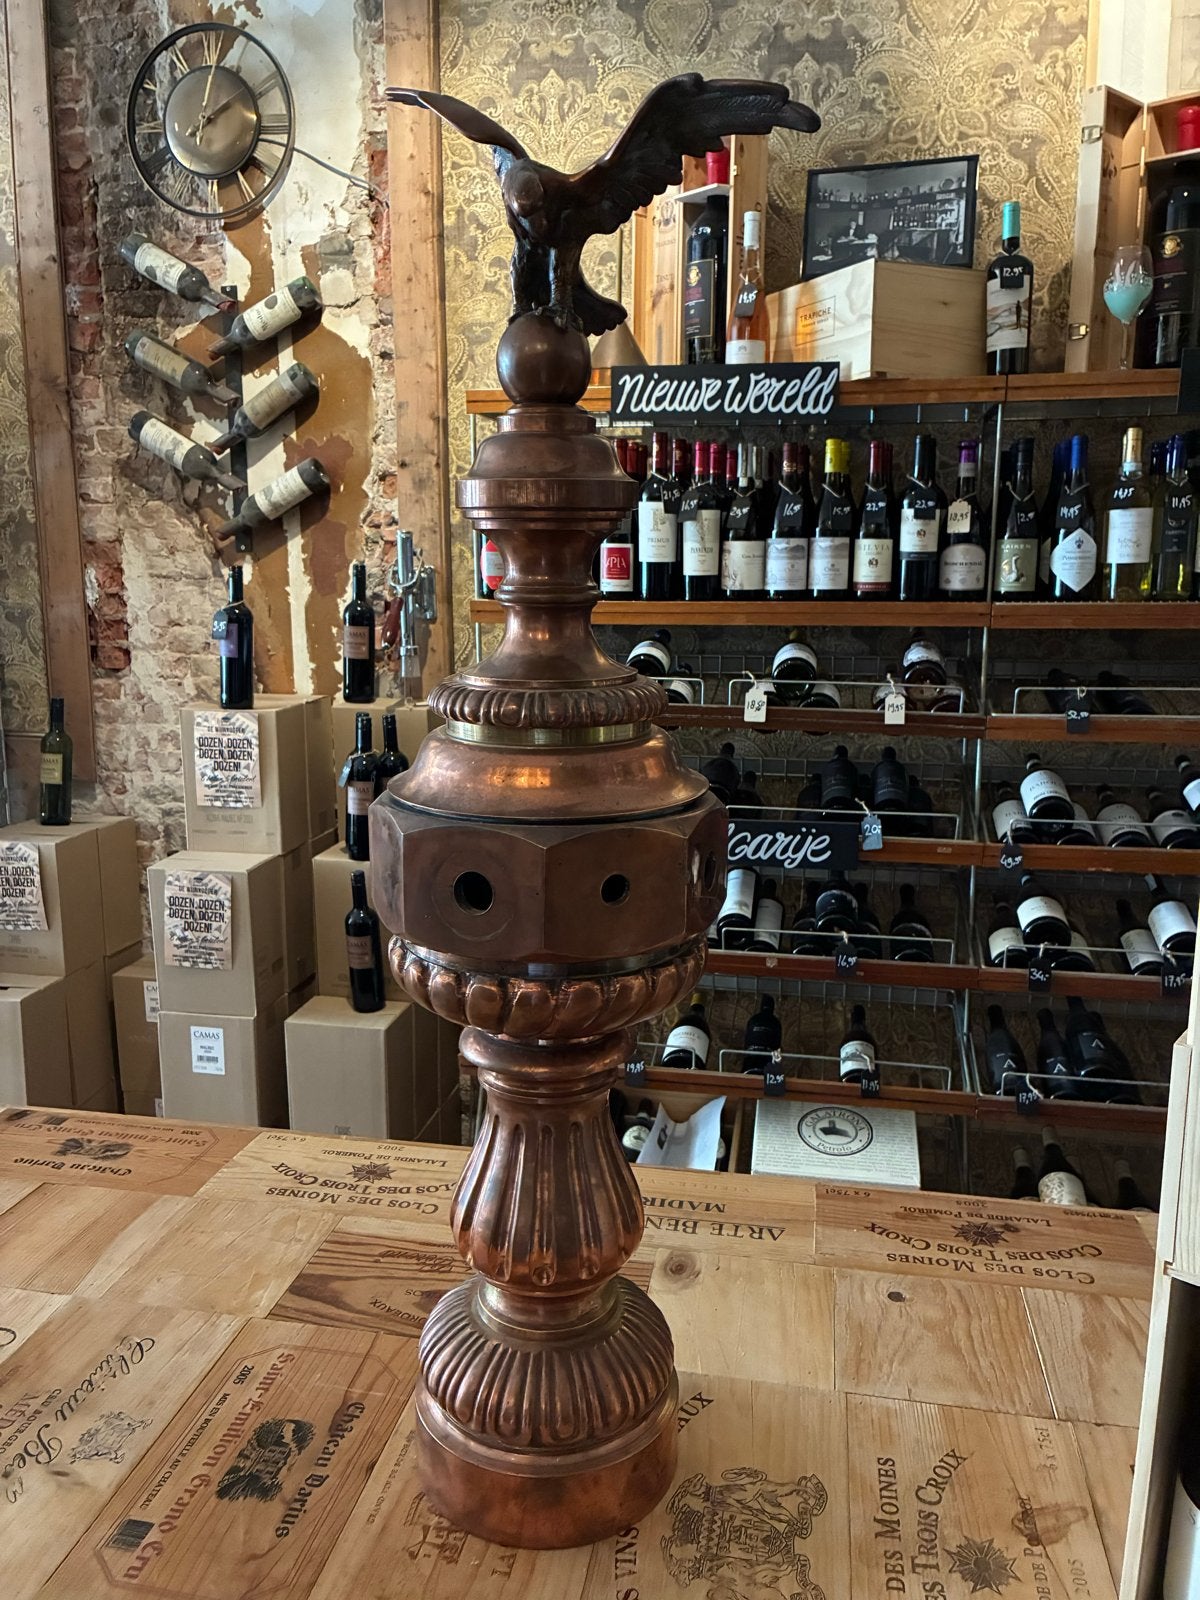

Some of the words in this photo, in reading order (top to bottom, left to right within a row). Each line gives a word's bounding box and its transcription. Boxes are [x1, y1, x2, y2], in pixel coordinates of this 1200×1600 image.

[799, 306, 832, 323] TRAPICHE
[616, 372, 722, 414] Nieuwe
[723, 366, 839, 415] Wereld
[193, 1030, 220, 1040] CAMAS
[804, 1110, 865, 1132] GALATRONA
[321, 1149, 374, 1161] POMEROL
[816, 1142, 852, 1152] Petrolo
[376, 1154, 391, 1162] DE
[395, 1156, 449, 1168] LALANDE
[271, 1161, 319, 1186] CROIX
[265, 1187, 341, 1205] MOINES
[320, 1179, 376, 1195] TROIS
[377, 1185, 412, 1195] DES
[346, 1195, 382, 1206] DES
[388, 1198, 440, 1215] CLOS
[641, 1195, 727, 1214] MADIR
[899, 1205, 963, 1219] POMEROL
[645, 1216, 700, 1236] BEN
[709, 1221, 787, 1242] ARTE
[864, 1222, 932, 1251] CROIX
[936, 1242, 1003, 1263] TROIS
[1007, 1250, 1047, 1262] DES
[1046, 1243, 1103, 1261] CLOS
[886, 1252, 977, 1274] MOINES
[984, 1262, 1026, 1275] DES
[1033, 1266, 1096, 1285] CLOS
[368, 1298, 429, 1326] ORDEAUX
[232, 1364, 255, 1386] 2005
[915, 1447, 969, 1506] CROIX
[873, 1456, 902, 1543] MOINES
[911, 1507, 941, 1576] TROIS
[614, 1525, 641, 1581] VINS
[884, 1549, 907, 1595] DES
